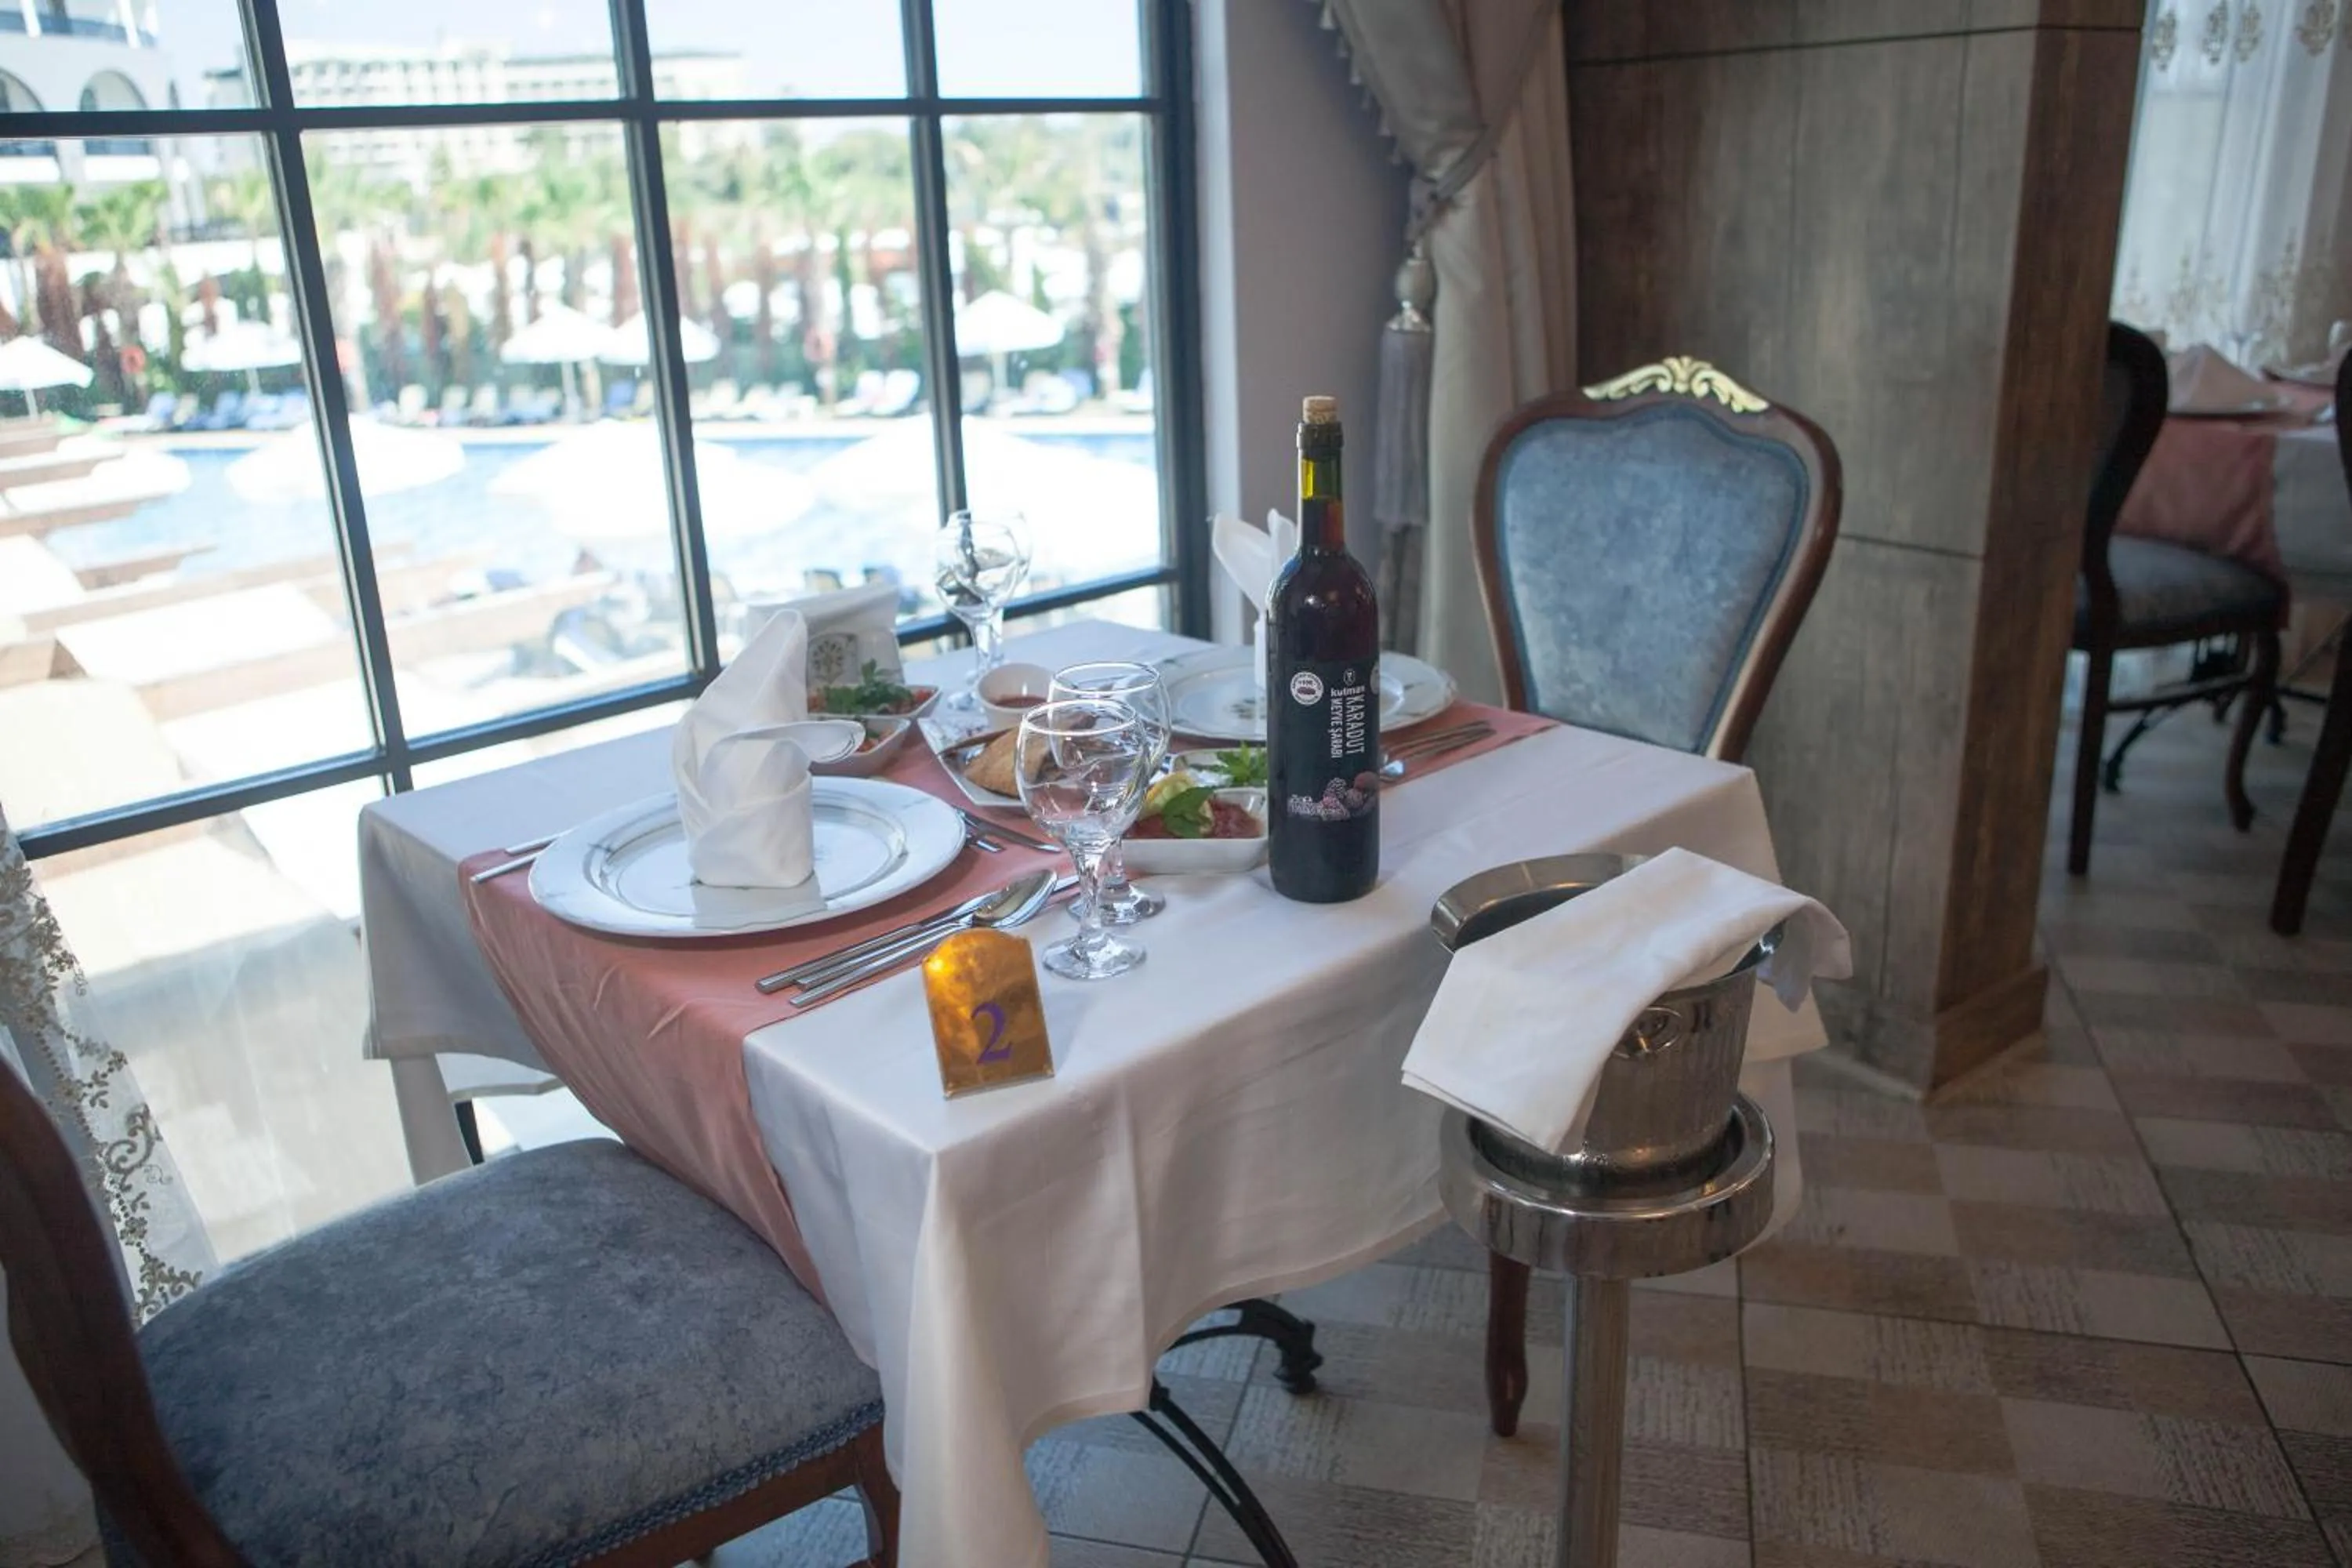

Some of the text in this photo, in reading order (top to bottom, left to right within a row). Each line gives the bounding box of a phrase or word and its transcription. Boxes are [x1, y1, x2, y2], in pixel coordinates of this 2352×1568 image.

[1330, 685, 1365, 697] kutman
[1328, 698, 1343, 758] MEYVE ŞARABI
[1345, 695, 1365, 753] KARADUT
[971, 1001, 1012, 1065] 2
